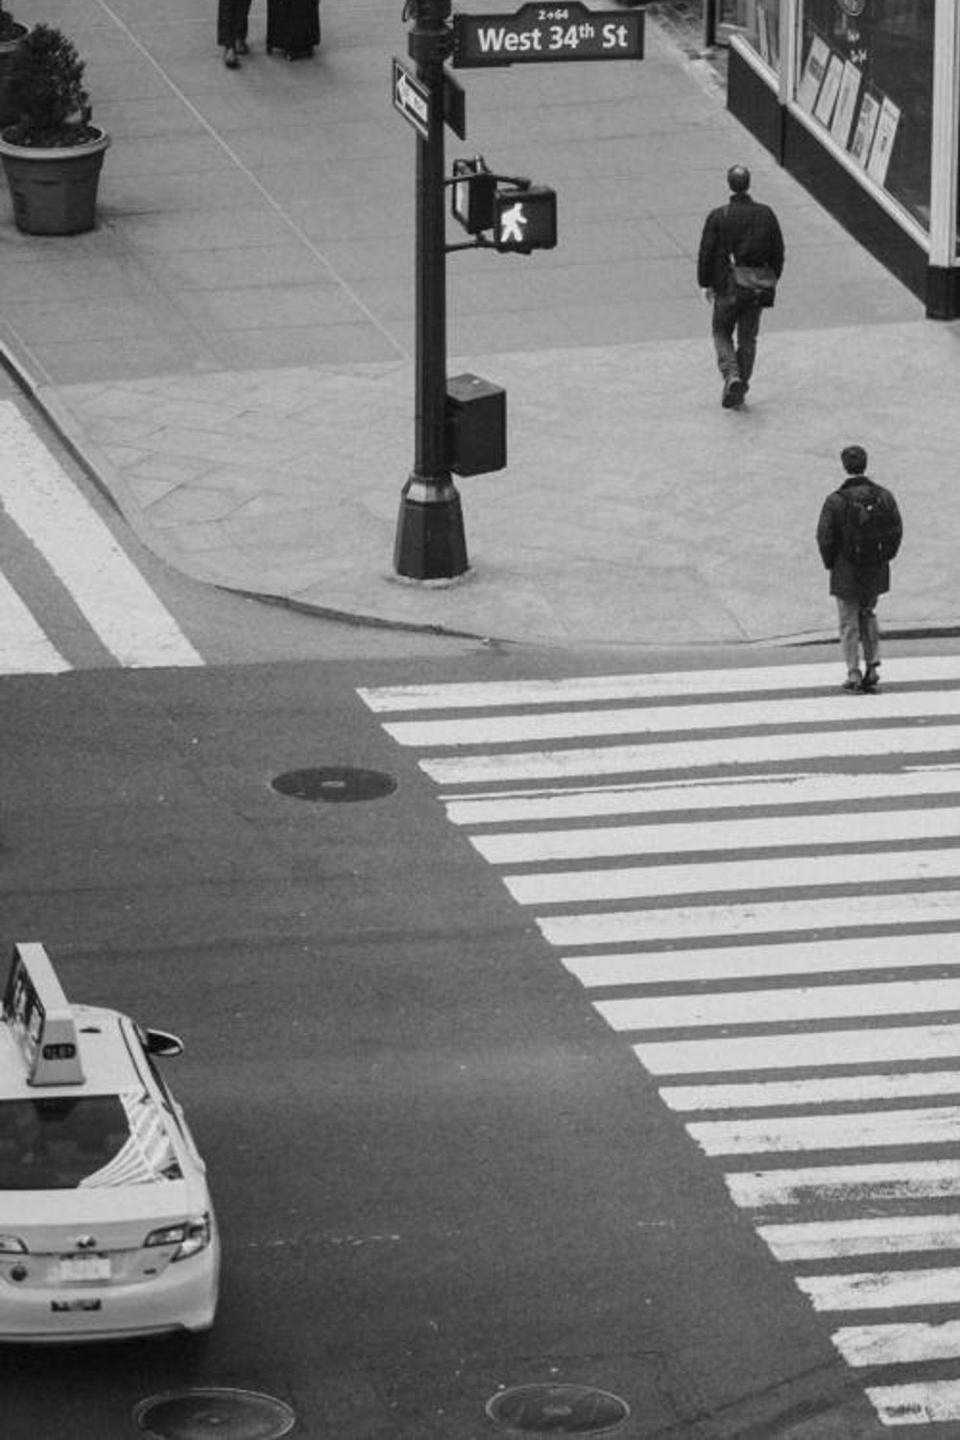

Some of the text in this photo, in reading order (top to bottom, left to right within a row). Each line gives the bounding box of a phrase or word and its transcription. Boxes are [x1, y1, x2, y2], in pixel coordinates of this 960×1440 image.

[477, 22, 629, 53] West 34th St
